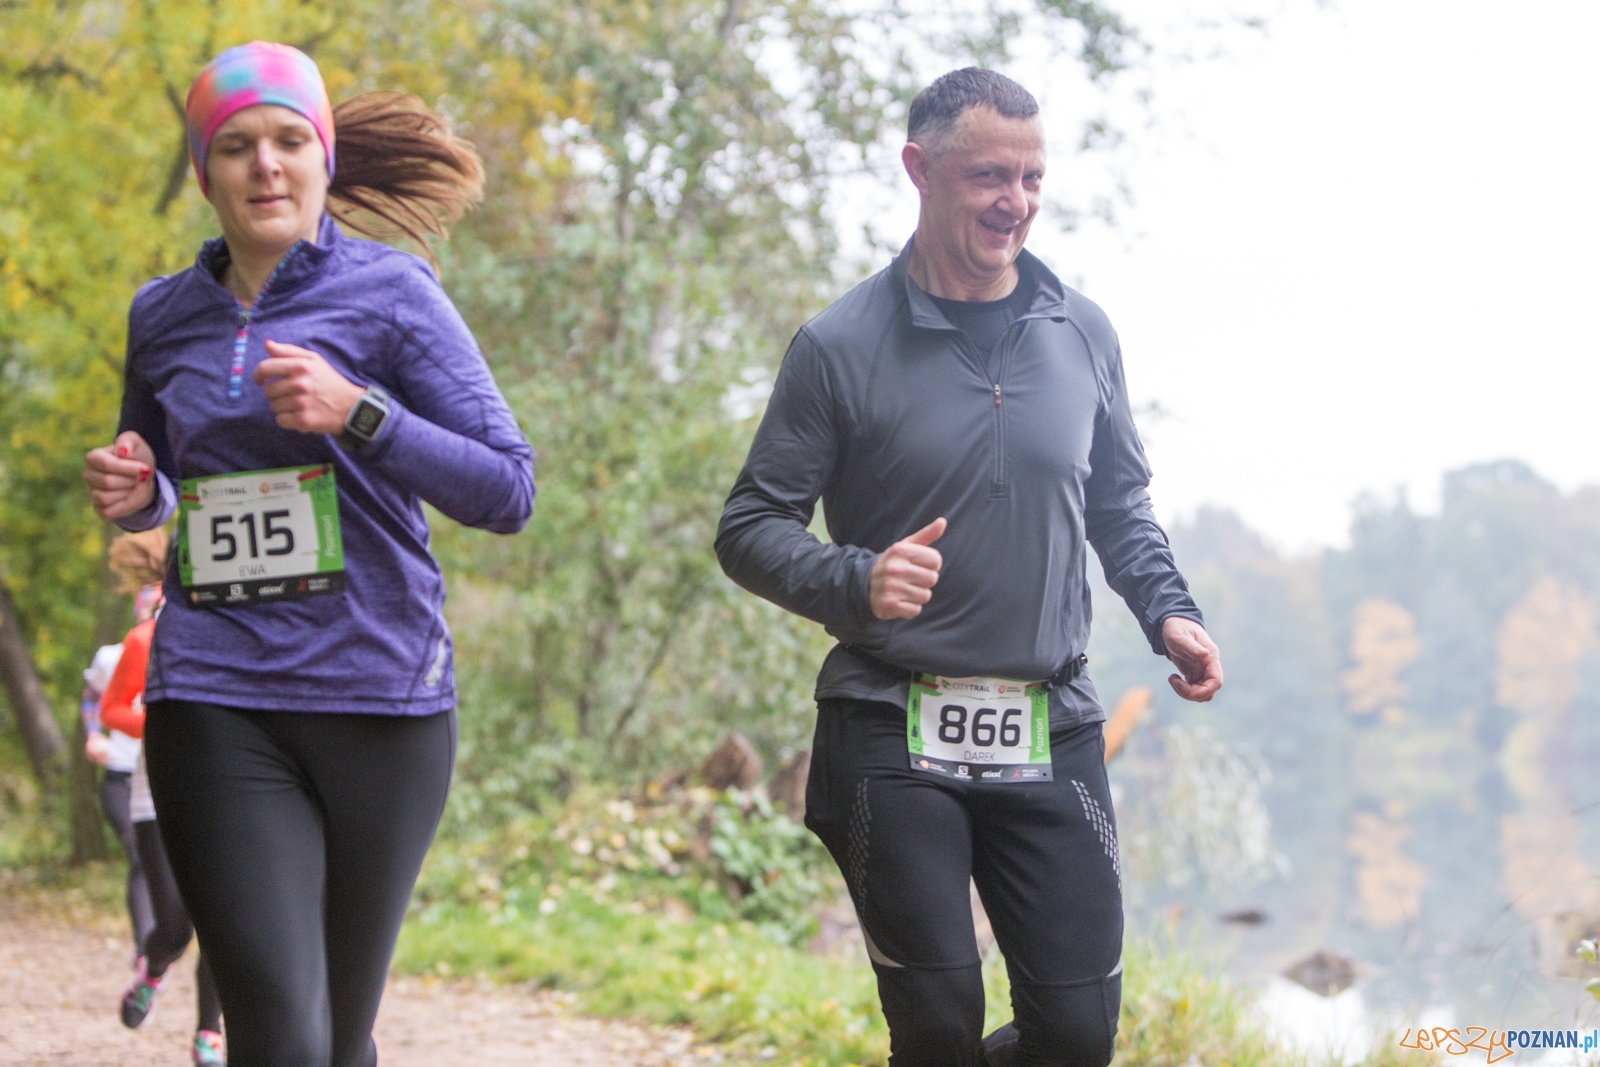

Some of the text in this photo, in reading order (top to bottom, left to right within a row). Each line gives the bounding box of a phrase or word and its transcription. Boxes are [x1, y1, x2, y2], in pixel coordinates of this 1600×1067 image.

[210, 509, 295, 561] 515
[239, 564, 266, 577] EWA
[938, 704, 1022, 747] 866
[1036, 717, 1044, 753] Poznań
[963, 751, 995, 762] DAREK
